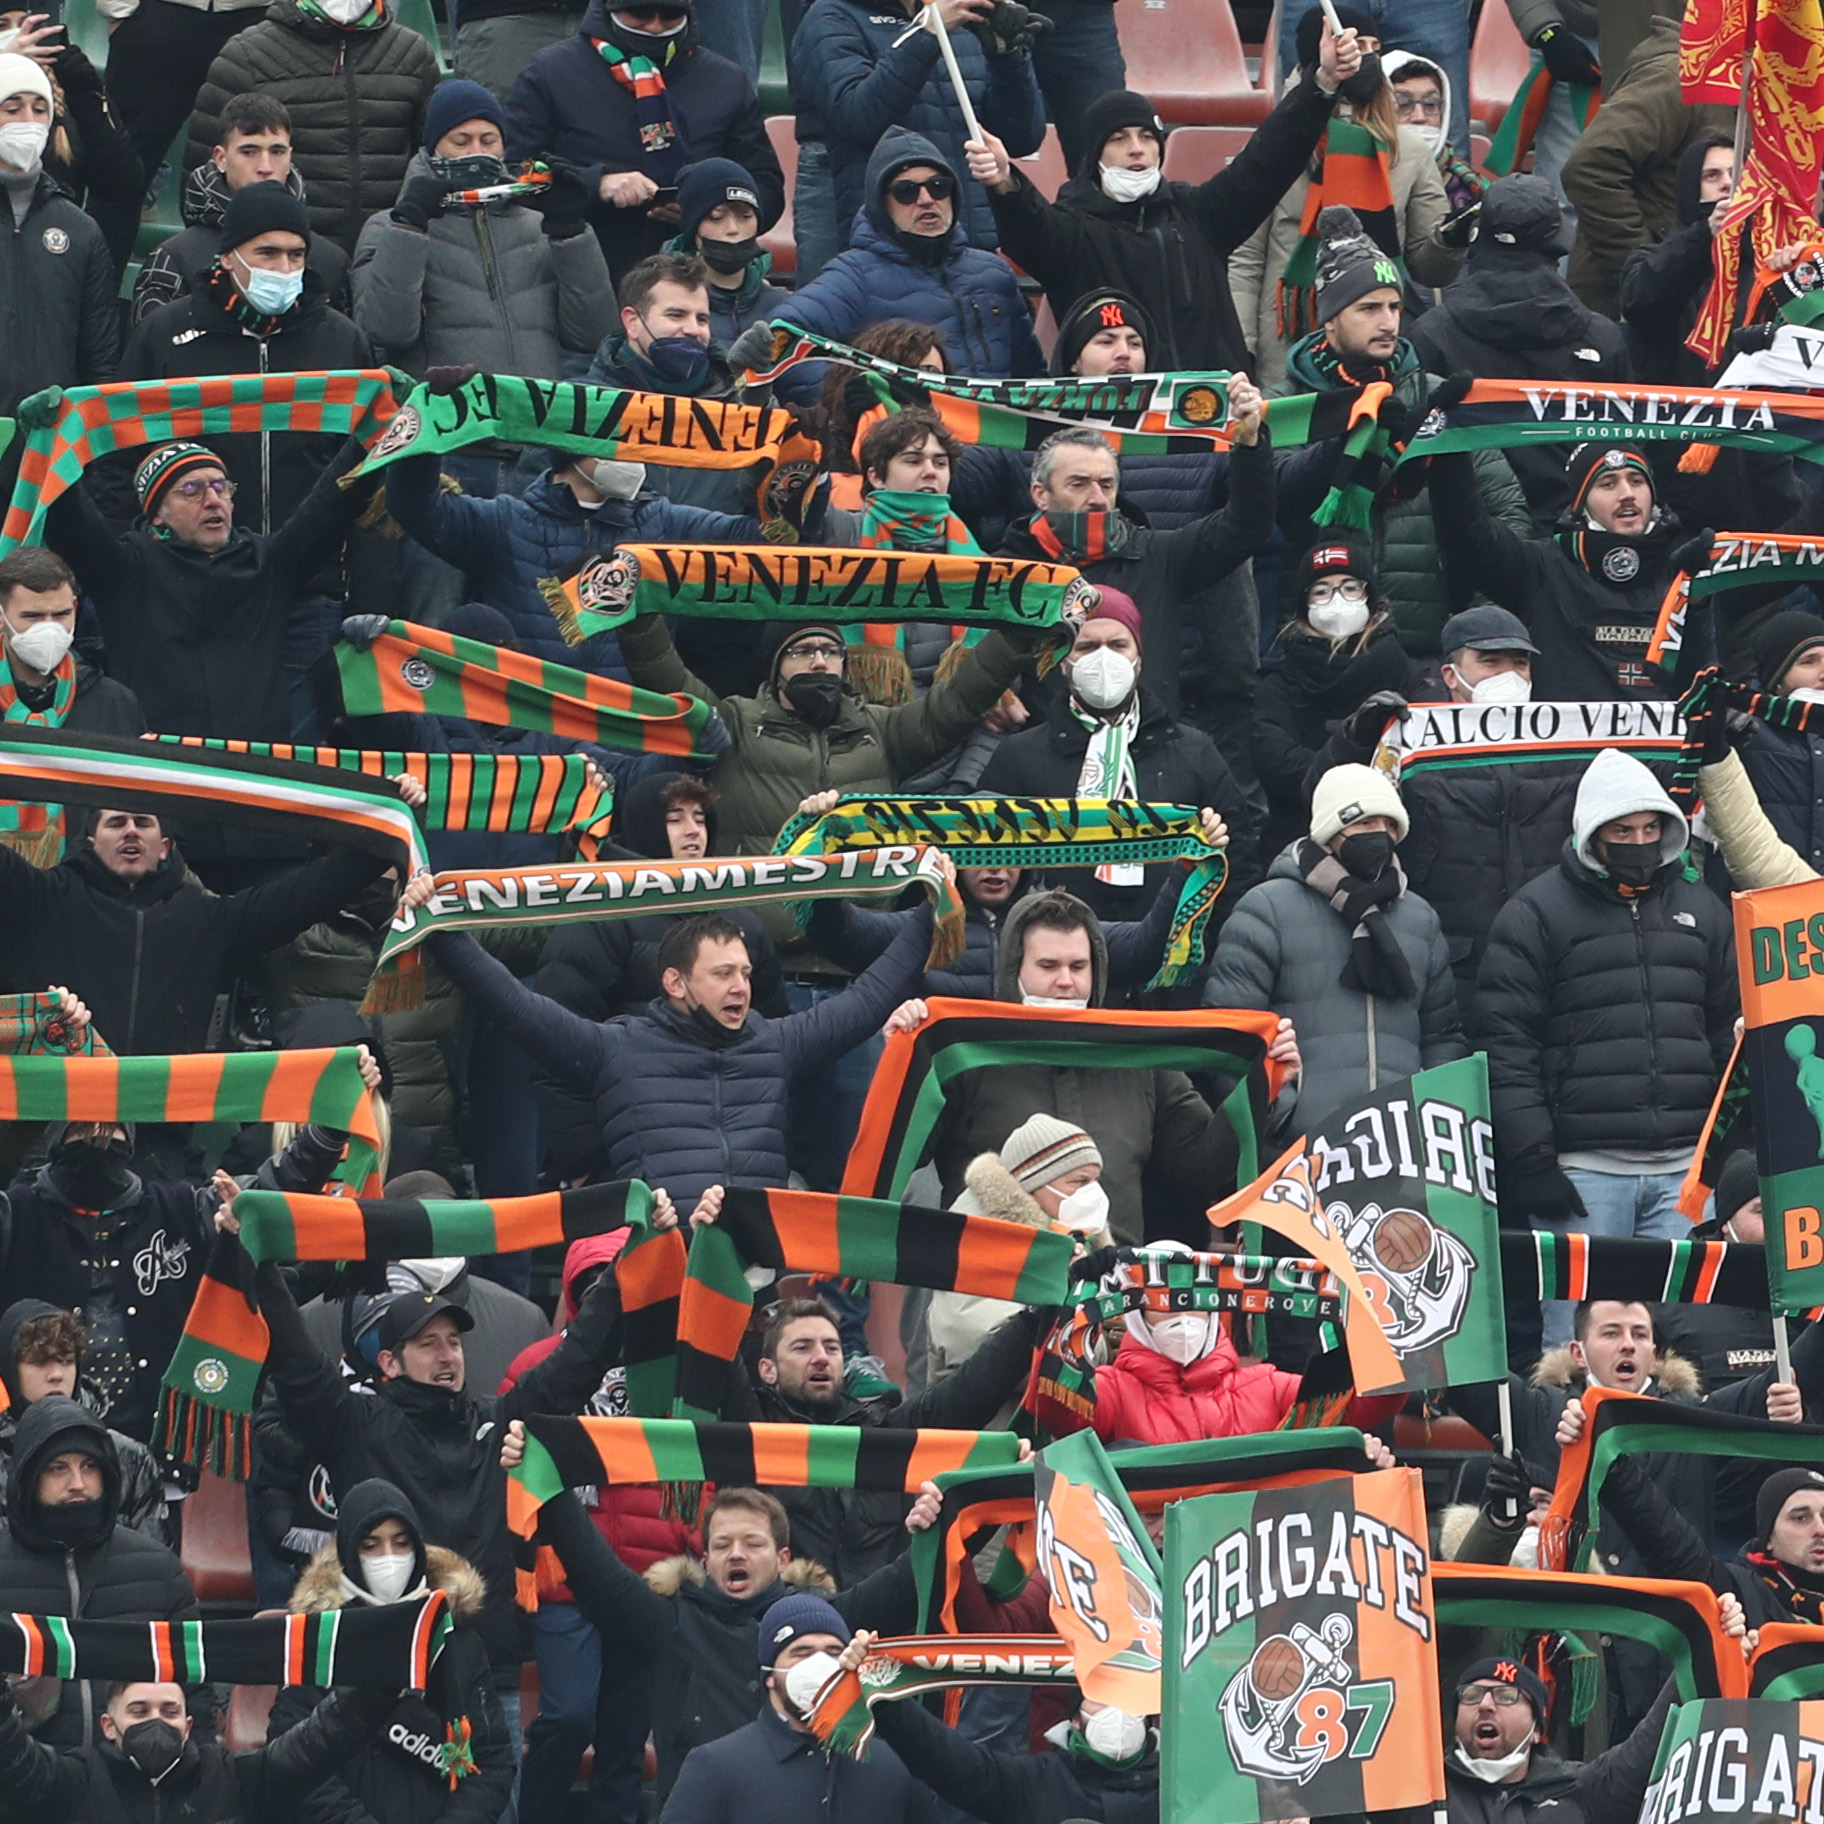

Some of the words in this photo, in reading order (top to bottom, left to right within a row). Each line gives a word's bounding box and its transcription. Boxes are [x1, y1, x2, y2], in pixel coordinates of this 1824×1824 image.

[1519, 386, 1777, 431] VENEZIA
[1574, 426, 1668, 440] FOOTBALL
[659, 550, 946, 613] VENEZIA
[969, 562, 1057, 619] FC
[1181, 1510, 1432, 1670] BRIGATE
[1295, 1679, 1394, 1763] 87
